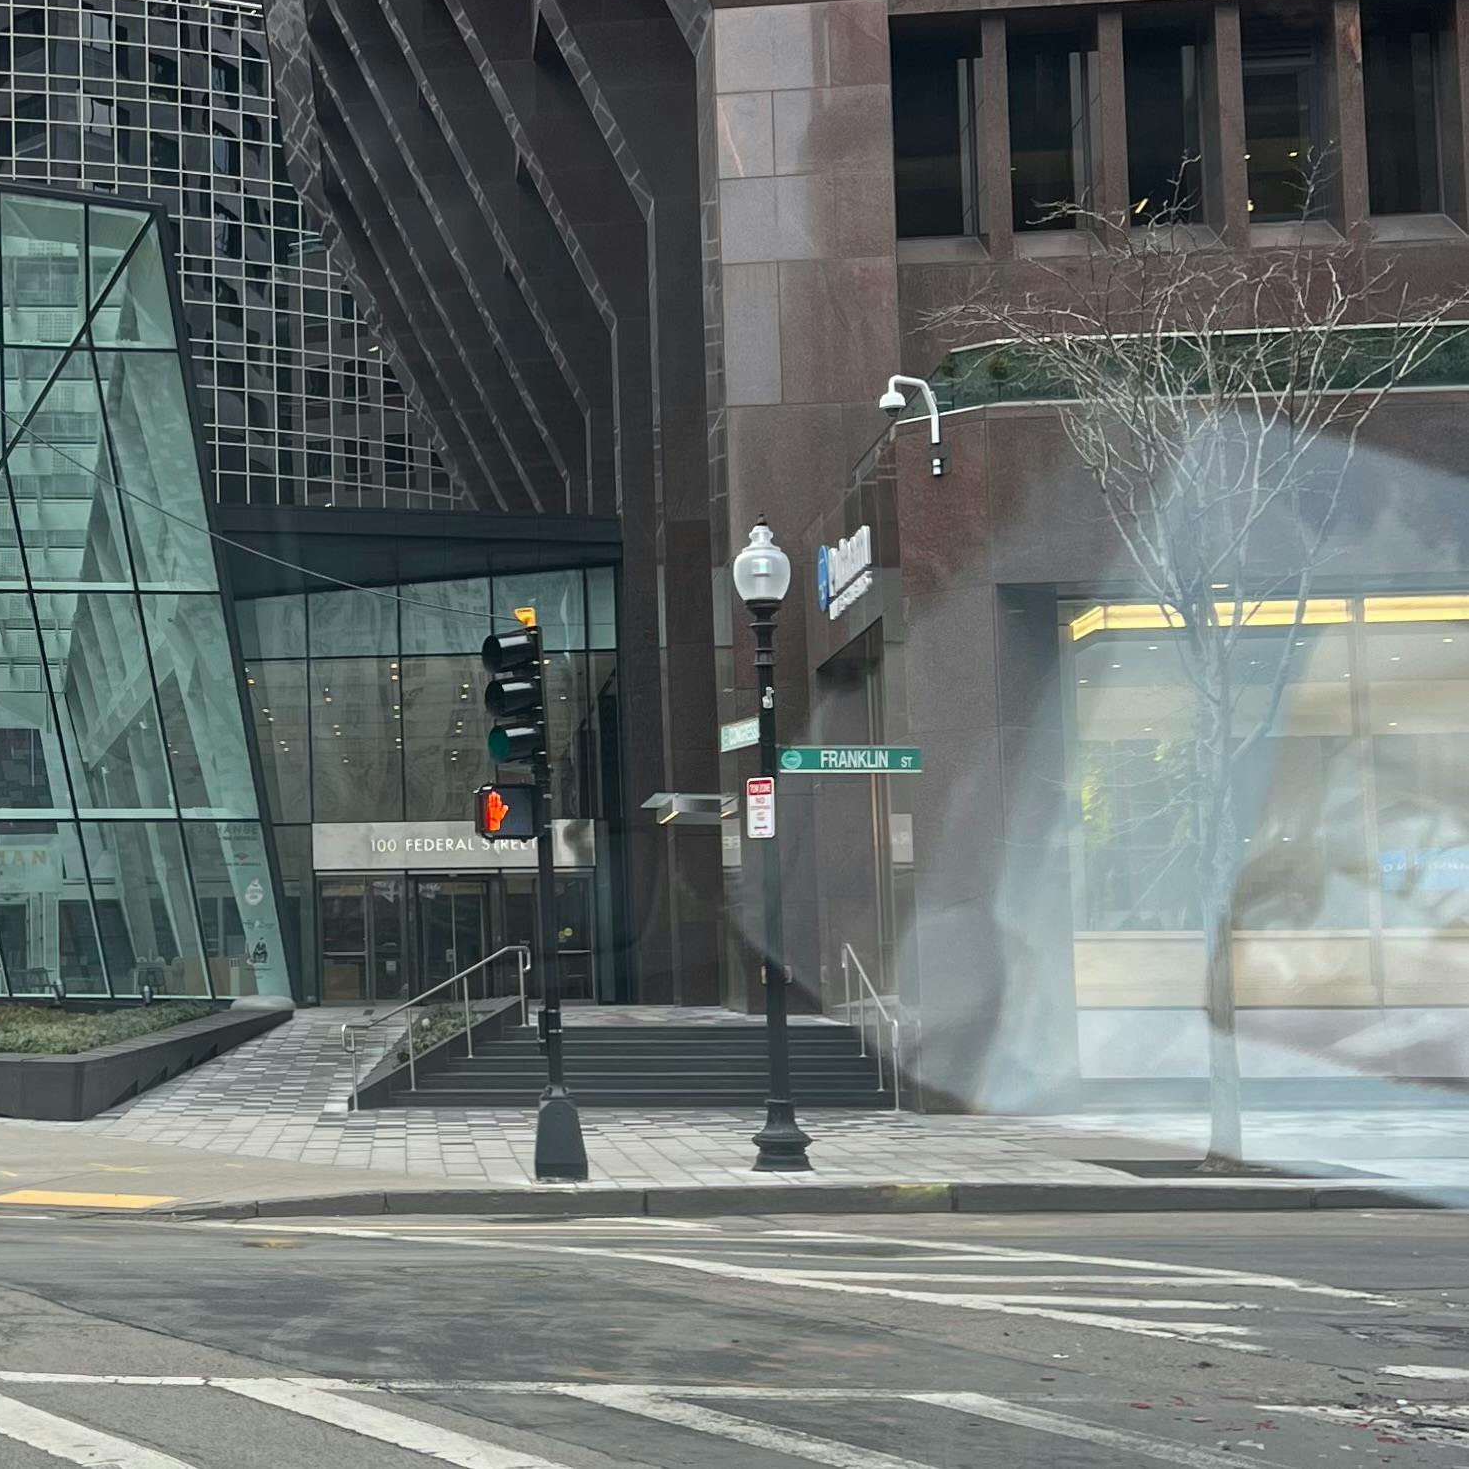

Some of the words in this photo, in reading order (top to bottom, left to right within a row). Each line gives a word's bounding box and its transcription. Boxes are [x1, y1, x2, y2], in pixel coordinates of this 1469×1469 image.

[820, 750, 889, 768] FRANKLIN
[900, 756, 913, 768] ST
[370, 838, 397, 853] 100
[405, 838, 474, 852] FEDERAL
